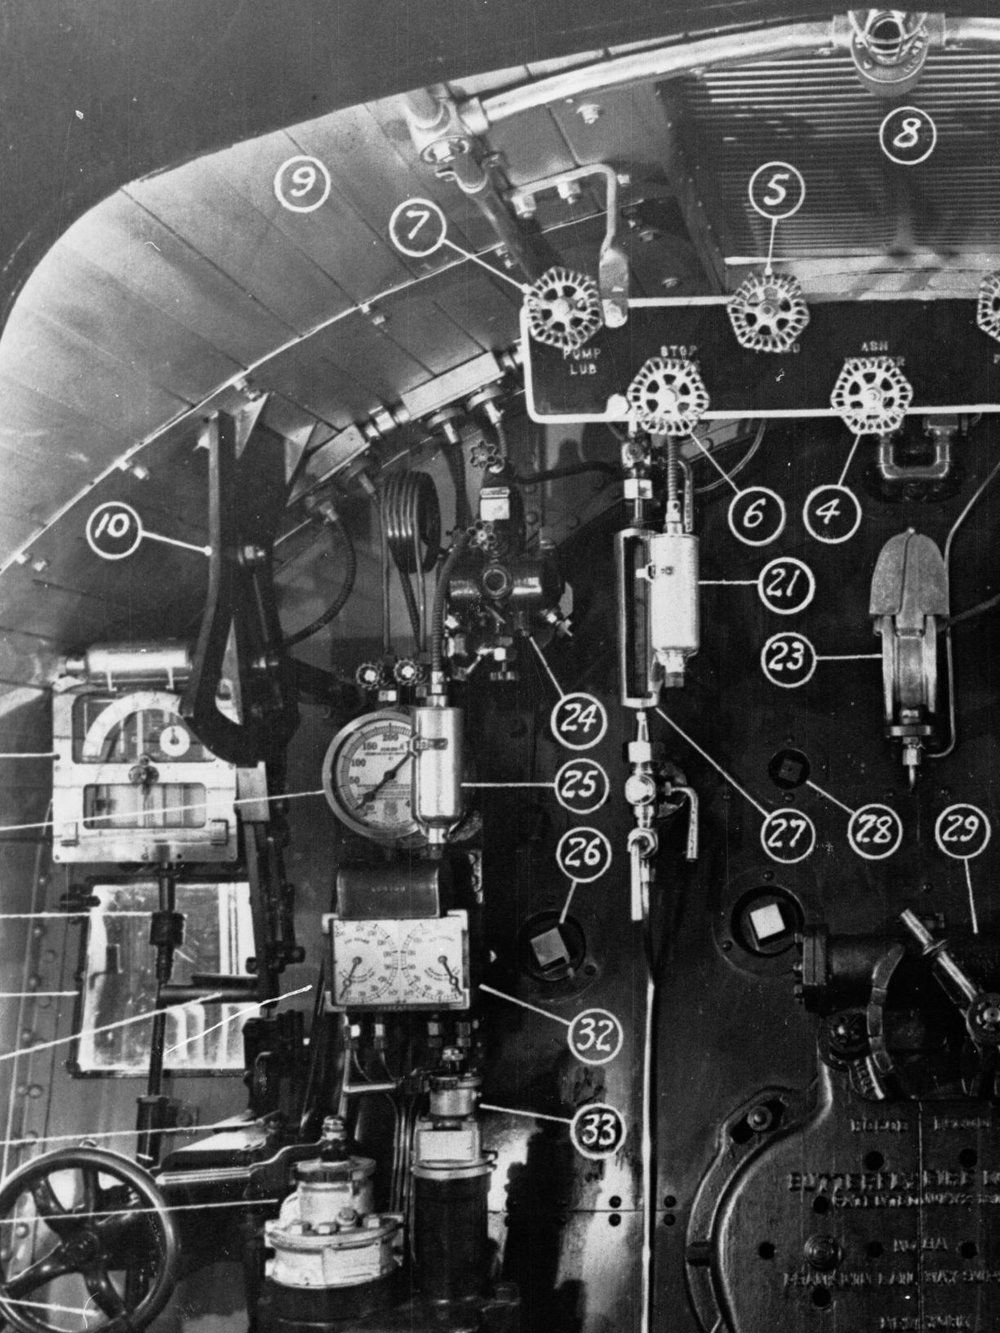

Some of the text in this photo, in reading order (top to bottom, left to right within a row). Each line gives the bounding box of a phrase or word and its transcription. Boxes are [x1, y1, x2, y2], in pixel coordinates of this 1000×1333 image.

[660, 344, 698, 357] STOP
[860, 340, 889, 352] ASH
[563, 347, 602, 360] PUMP
[569, 363, 598, 375] LUB
[381, 733, 399, 742] 200
[350, 758, 366, 768] 100
